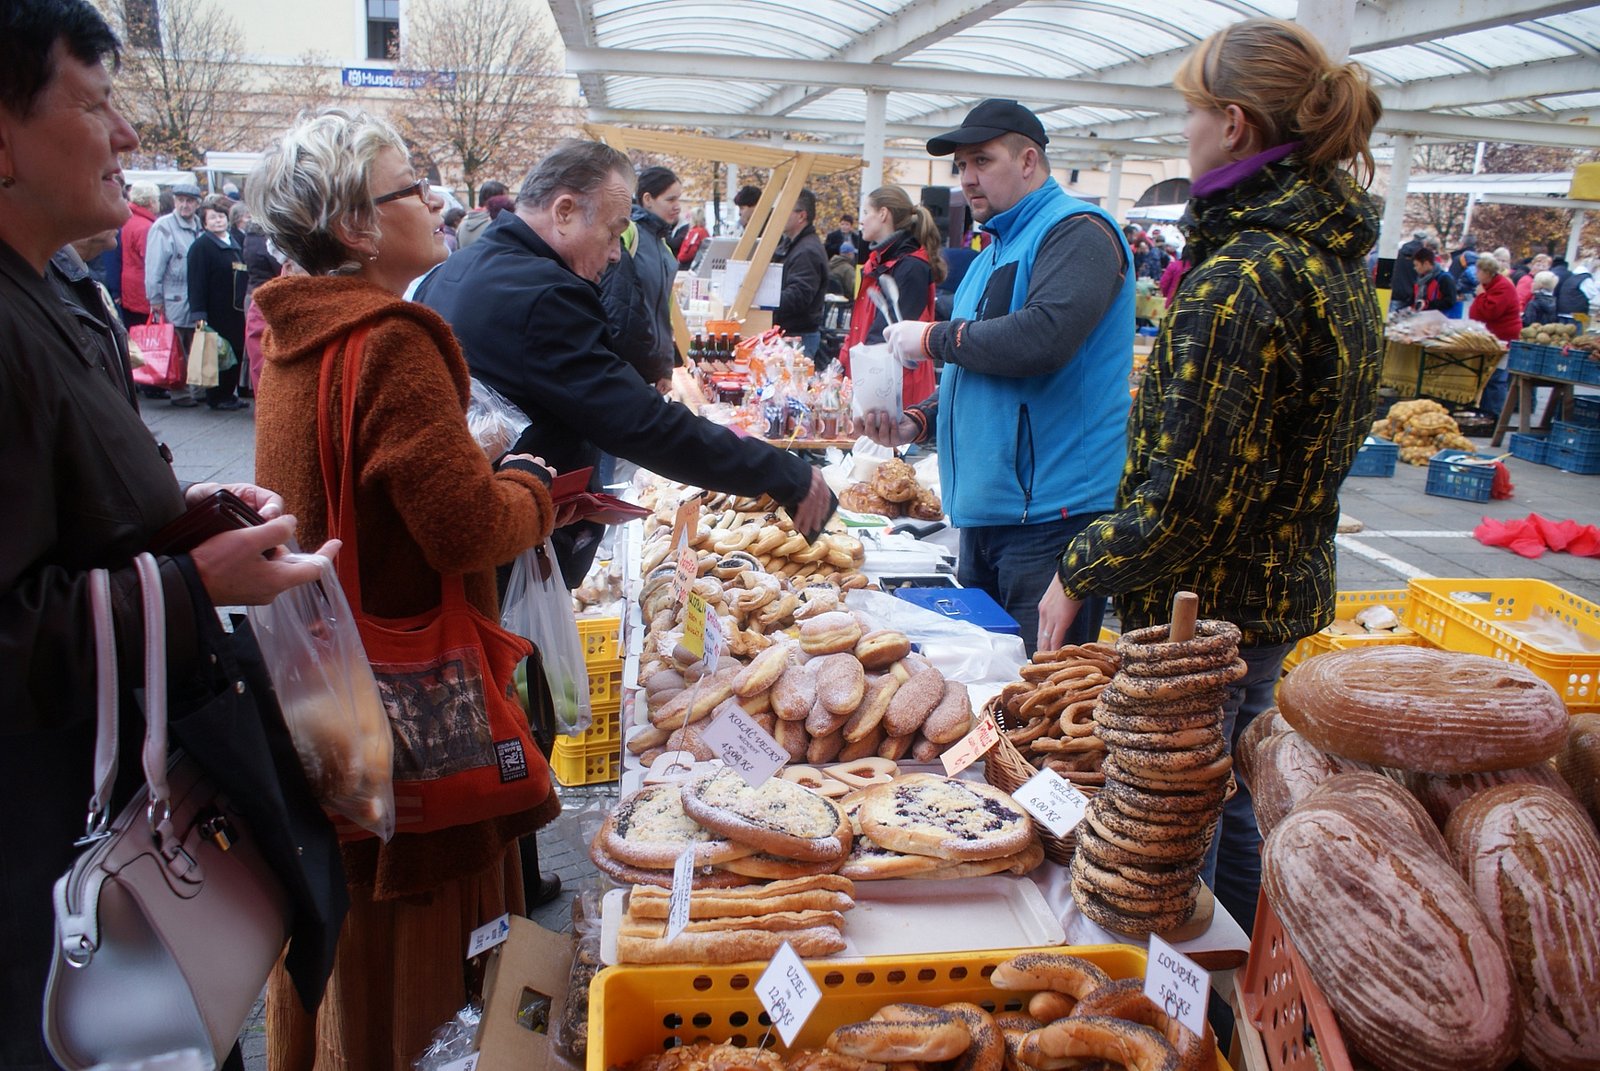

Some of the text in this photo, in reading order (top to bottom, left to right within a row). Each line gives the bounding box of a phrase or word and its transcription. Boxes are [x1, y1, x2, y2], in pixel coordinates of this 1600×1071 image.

[728, 711, 784, 763] KOLÁČ VELKÝ
[740, 758, 754, 772] Kč
[1030, 797, 1048, 812] 6,00
[1046, 809, 1061, 823] Kč
[786, 965, 807, 998] UZEL
[1157, 952, 1200, 993] LOUPÁK
[768, 986, 795, 1026] 12,00 Kč
[1159, 984, 1176, 1004] 5,00
[1176, 997, 1191, 1016] Kč
